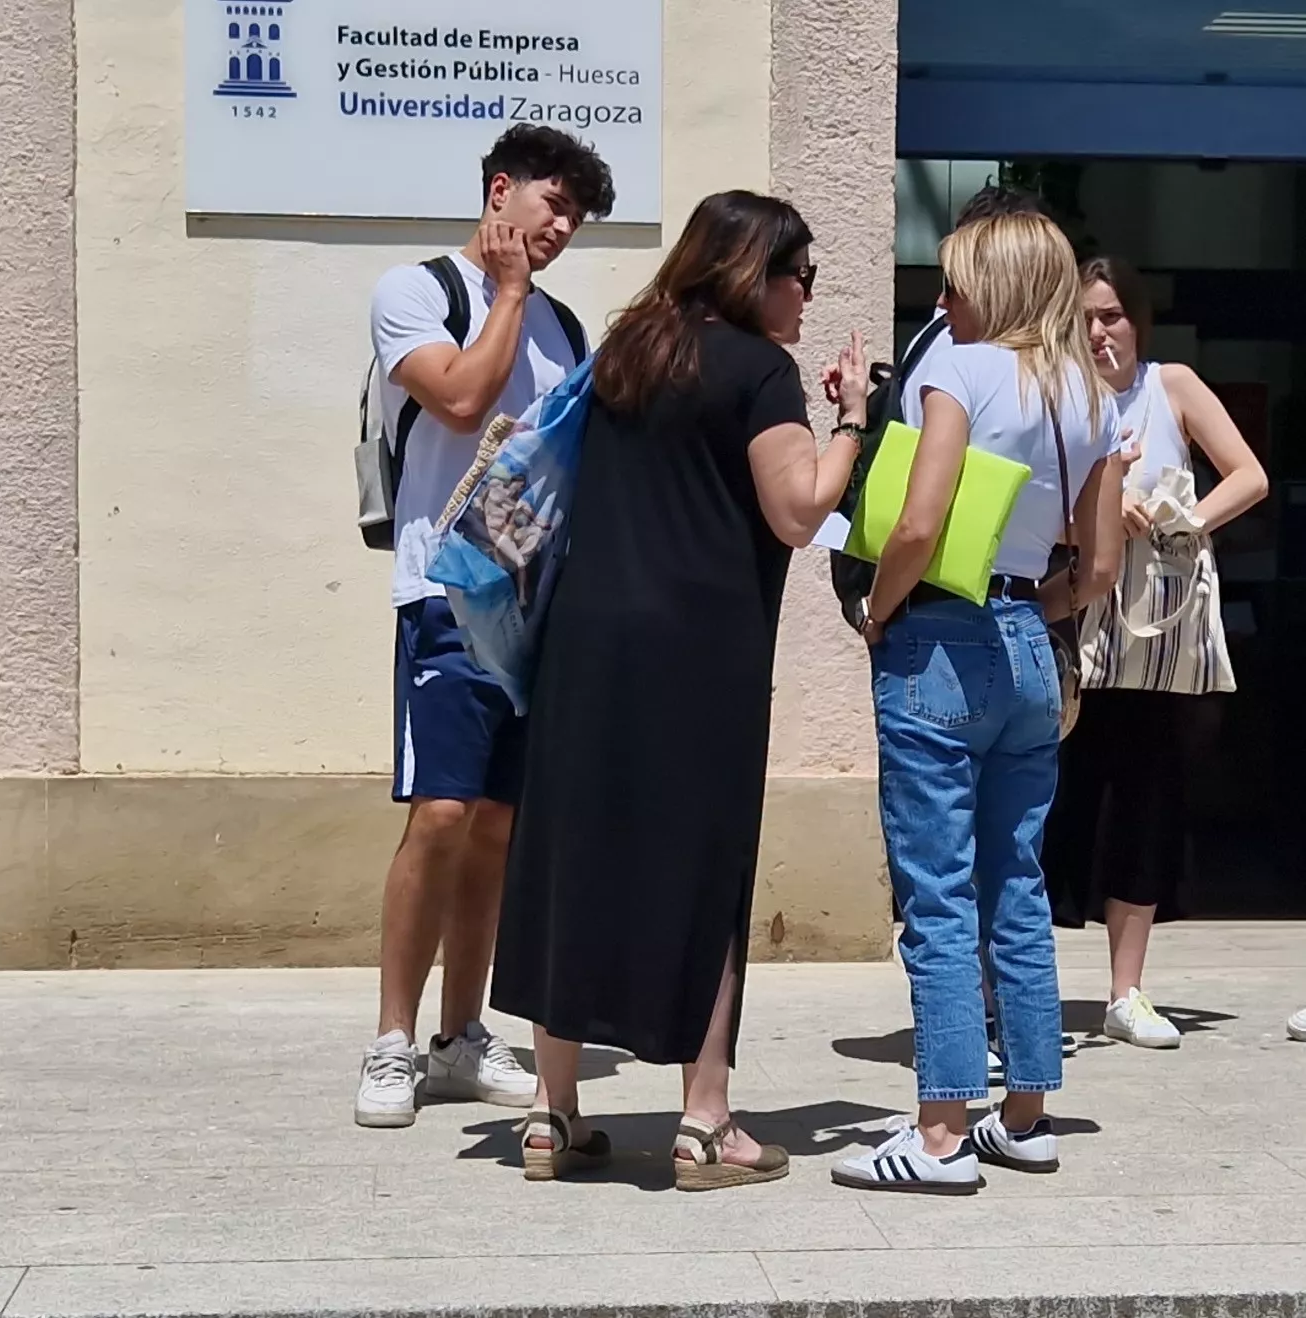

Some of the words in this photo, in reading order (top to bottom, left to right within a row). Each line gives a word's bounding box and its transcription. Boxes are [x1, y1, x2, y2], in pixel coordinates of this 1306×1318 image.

[337, 25, 438, 47] Facultad
[444, 28, 473, 48] de
[479, 30, 579, 55] Empresa
[337, 62, 350, 82] y
[355, 58, 447, 80] Gestión
[454, 60, 539, 82] Pública
[559, 64, 640, 85] Huesca
[231, 105, 277, 119] 1542
[340, 91, 506, 120] Universidad
[509, 97, 643, 129] Zaragoza
